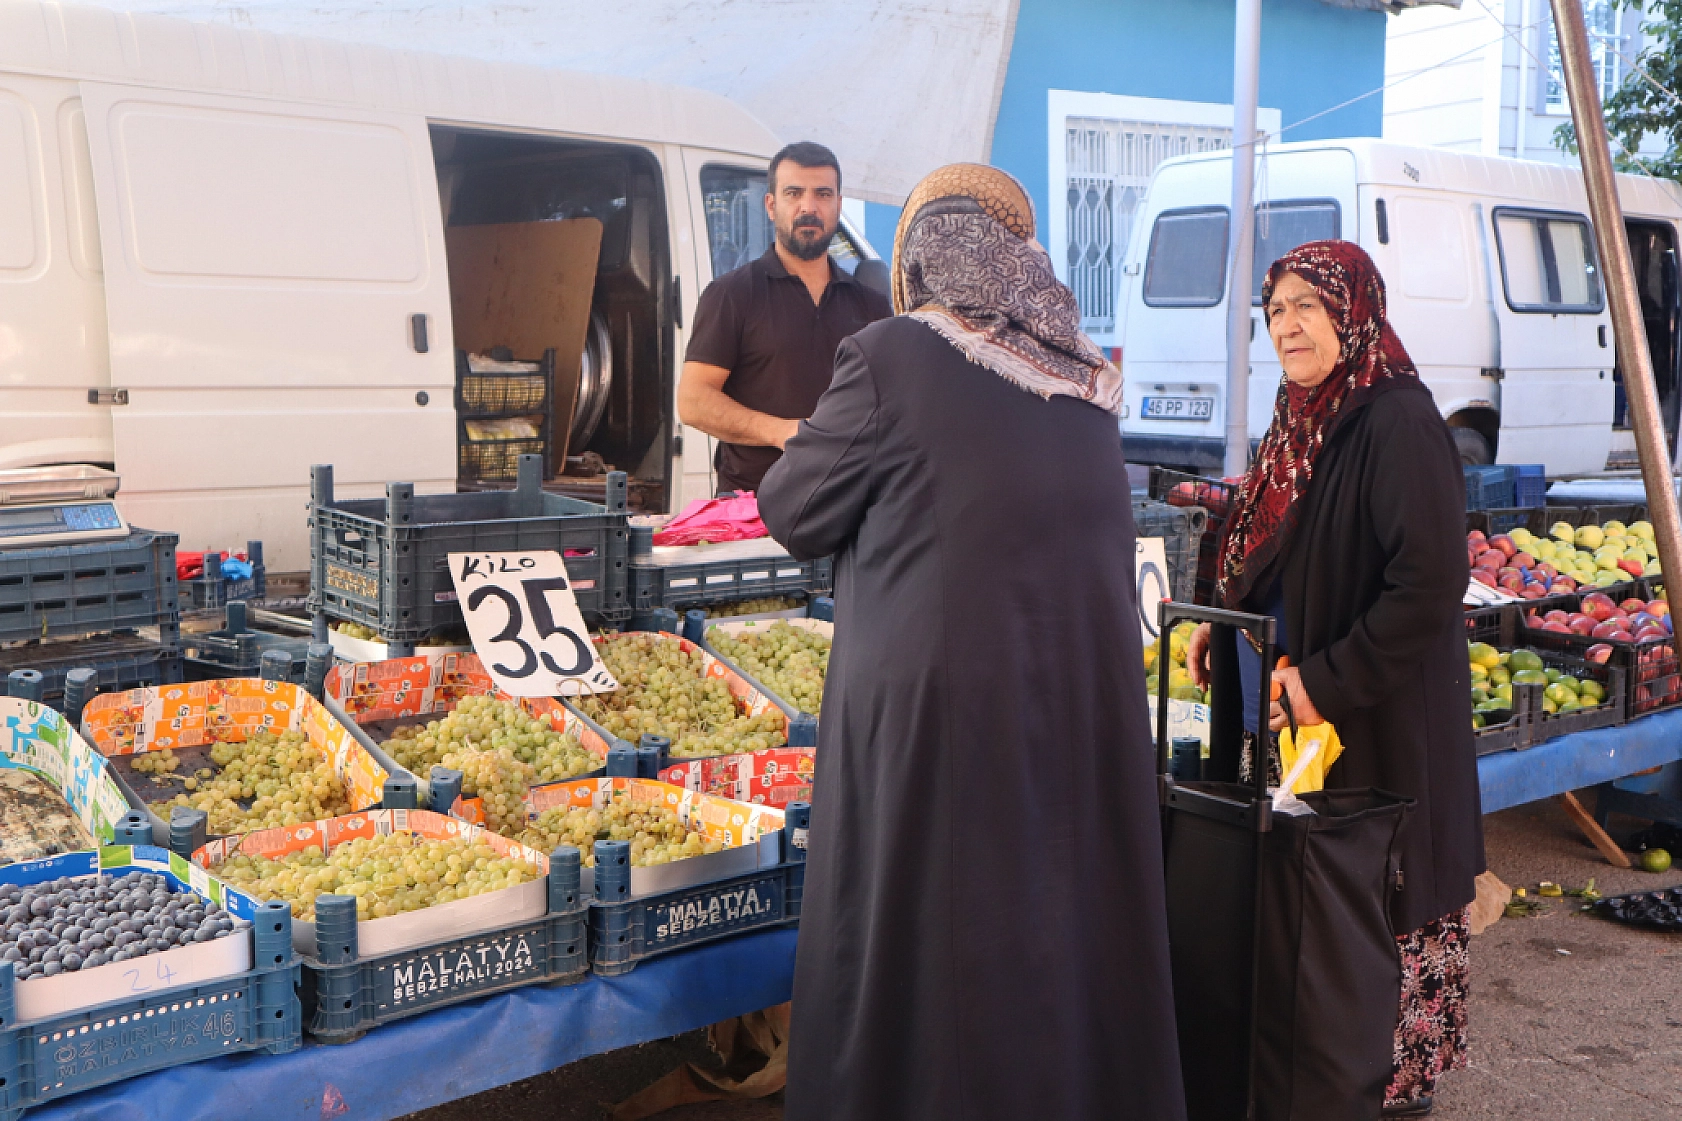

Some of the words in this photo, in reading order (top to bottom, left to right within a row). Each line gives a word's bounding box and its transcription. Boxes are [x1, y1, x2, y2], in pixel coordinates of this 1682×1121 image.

[1148, 400, 1162, 414] 46
[1165, 401, 1182, 414] PP
[1188, 401, 1209, 416] 123
[468, 577, 593, 678] 35
[656, 912, 721, 938] SEBZE
[669, 888, 758, 923] MALATYA
[393, 939, 531, 986] MALATYA
[393, 975, 449, 1000] SEBZE
[495, 955, 532, 974] 2024
[202, 1011, 236, 1040] 46
[59, 1034, 199, 1079] MALATYA
